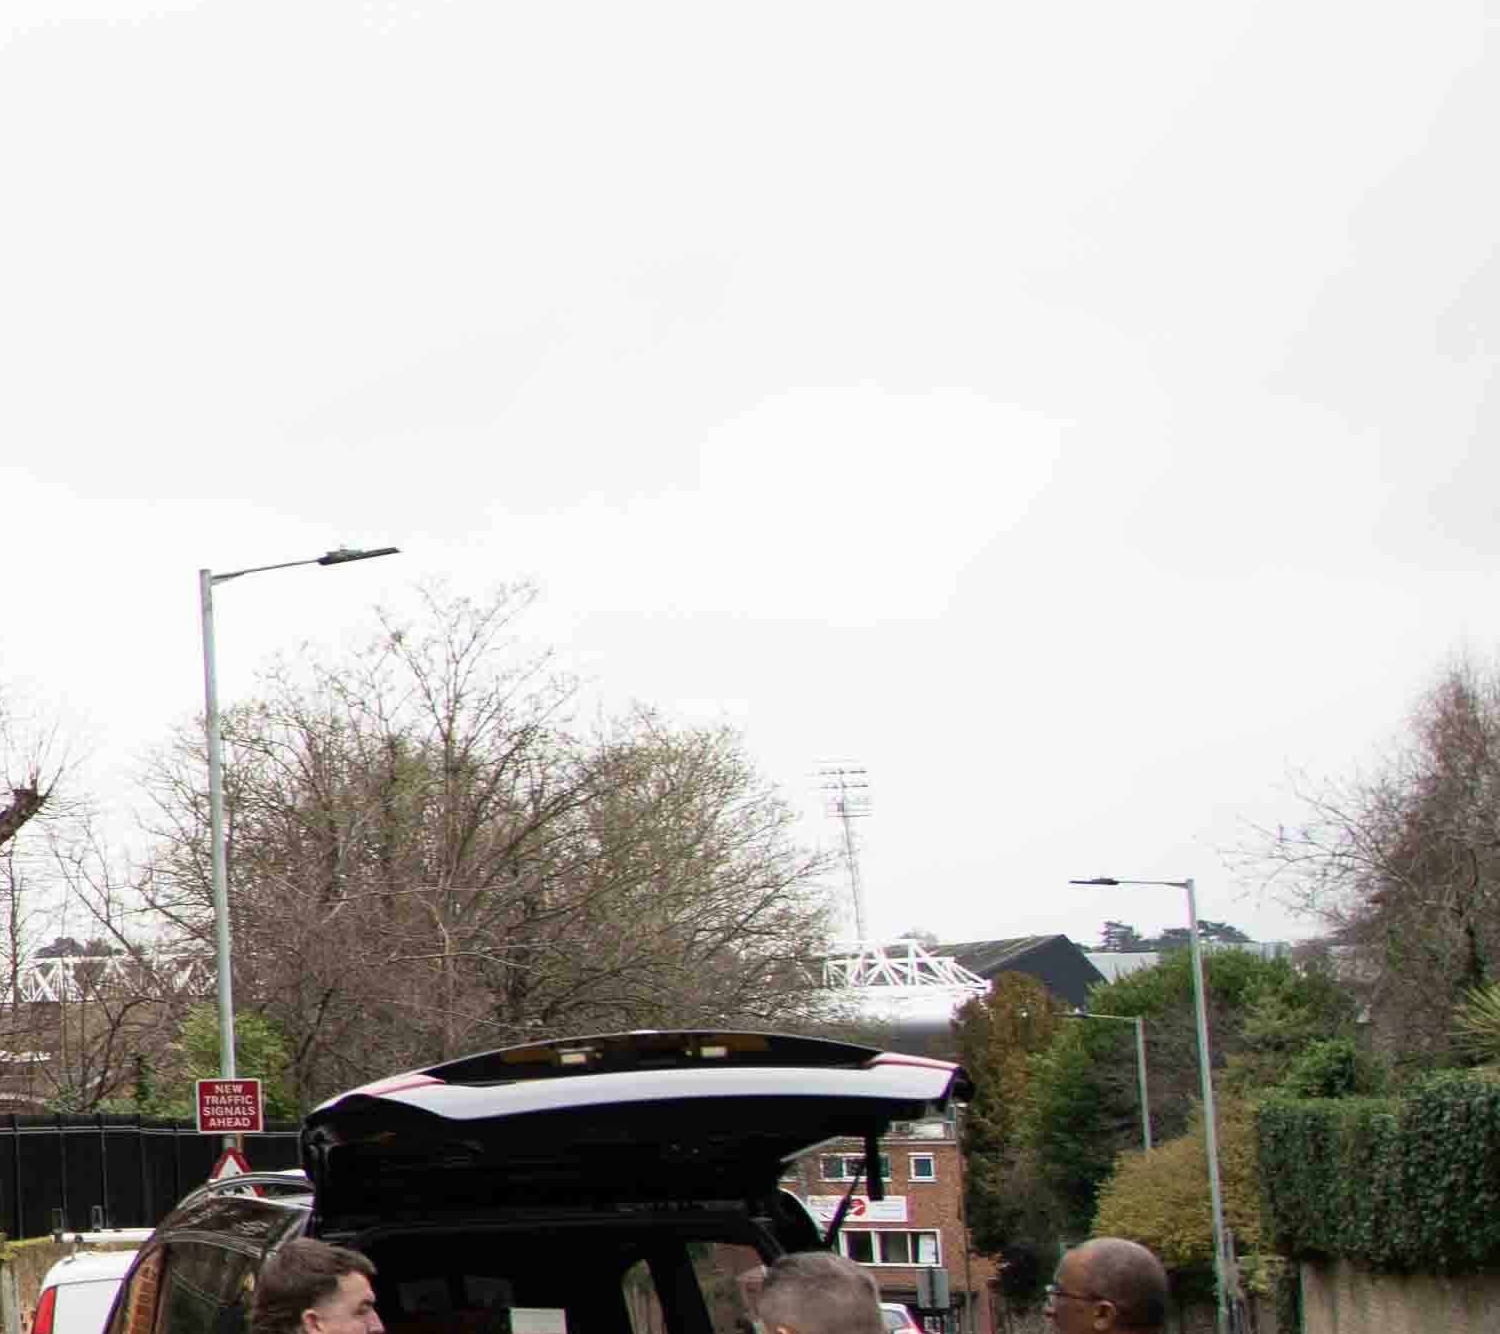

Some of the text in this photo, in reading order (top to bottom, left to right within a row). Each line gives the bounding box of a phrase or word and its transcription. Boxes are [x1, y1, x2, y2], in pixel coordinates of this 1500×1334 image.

[214, 1084, 243, 1094] NEW
[203, 1095, 253, 1105] TRAFFIC
[203, 1106, 256, 1116] SIGNALS
[209, 1117, 251, 1127] AHEAD
